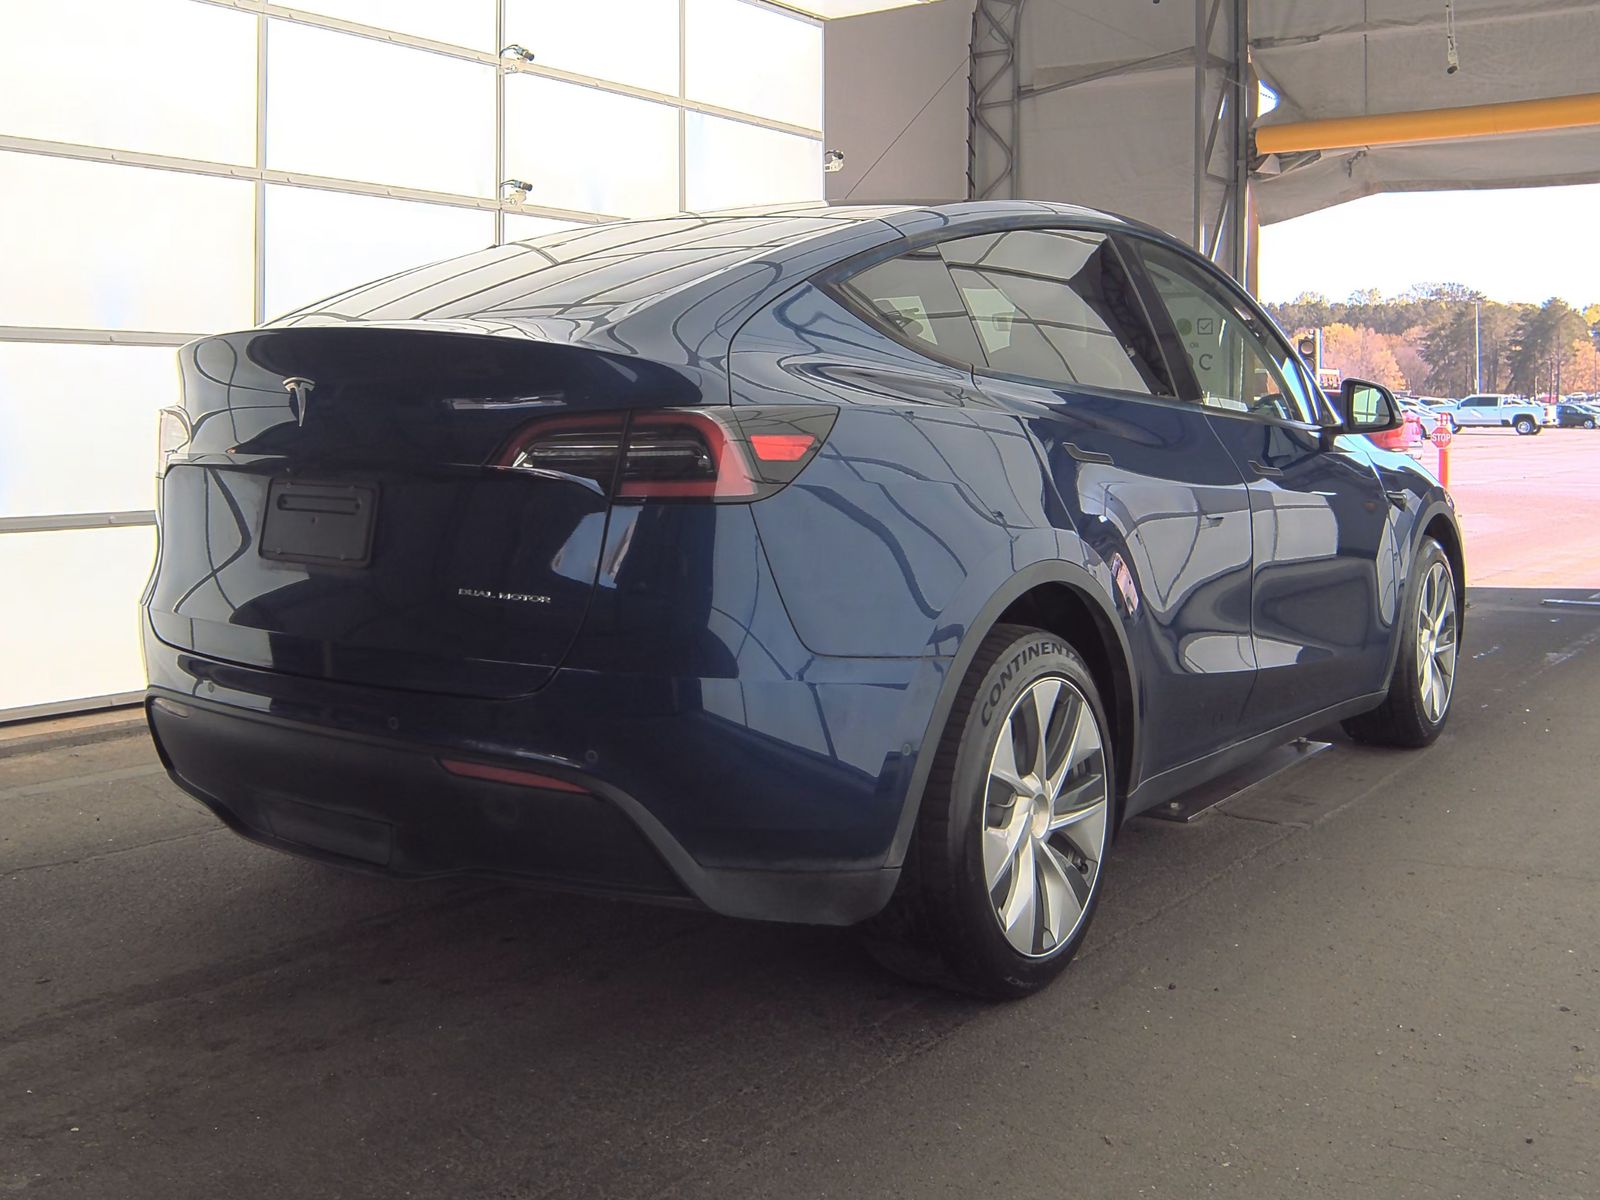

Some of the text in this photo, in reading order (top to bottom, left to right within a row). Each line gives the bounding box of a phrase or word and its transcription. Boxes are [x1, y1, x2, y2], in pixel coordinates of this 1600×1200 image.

[1432, 433, 1451, 441] STOP
[458, 588, 551, 603] DUAL MOTOR
